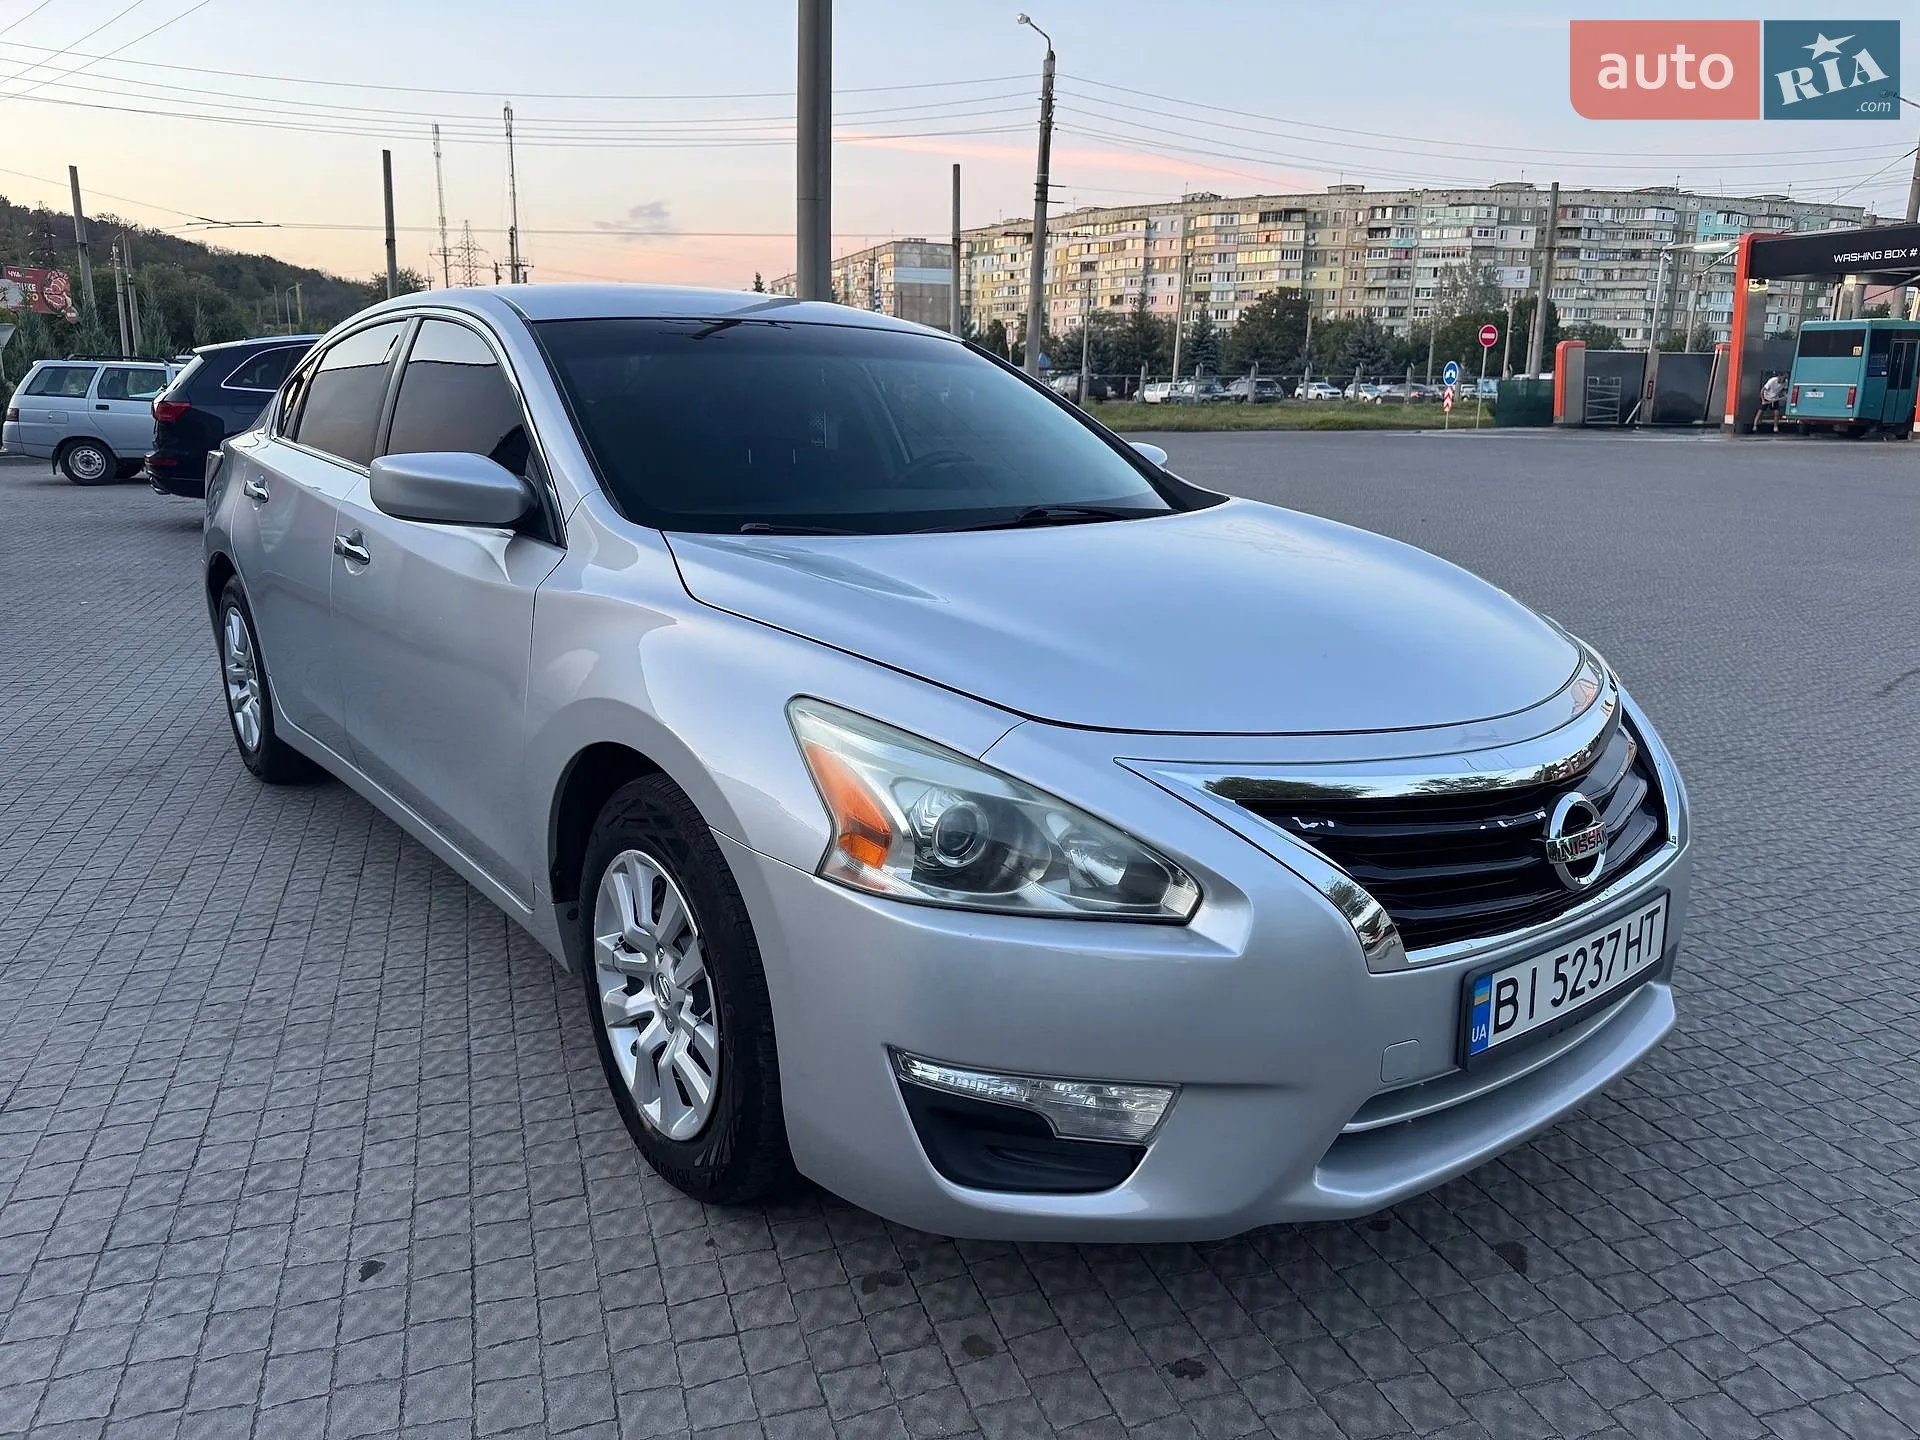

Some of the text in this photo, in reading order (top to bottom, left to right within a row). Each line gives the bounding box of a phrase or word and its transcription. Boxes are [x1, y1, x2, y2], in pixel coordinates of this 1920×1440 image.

[1834, 251, 1883, 263] WASHING
[1884, 248, 1907, 259] BOX
[1559, 829, 1607, 861] NISSAN
[1471, 1025, 1487, 1041] UA
